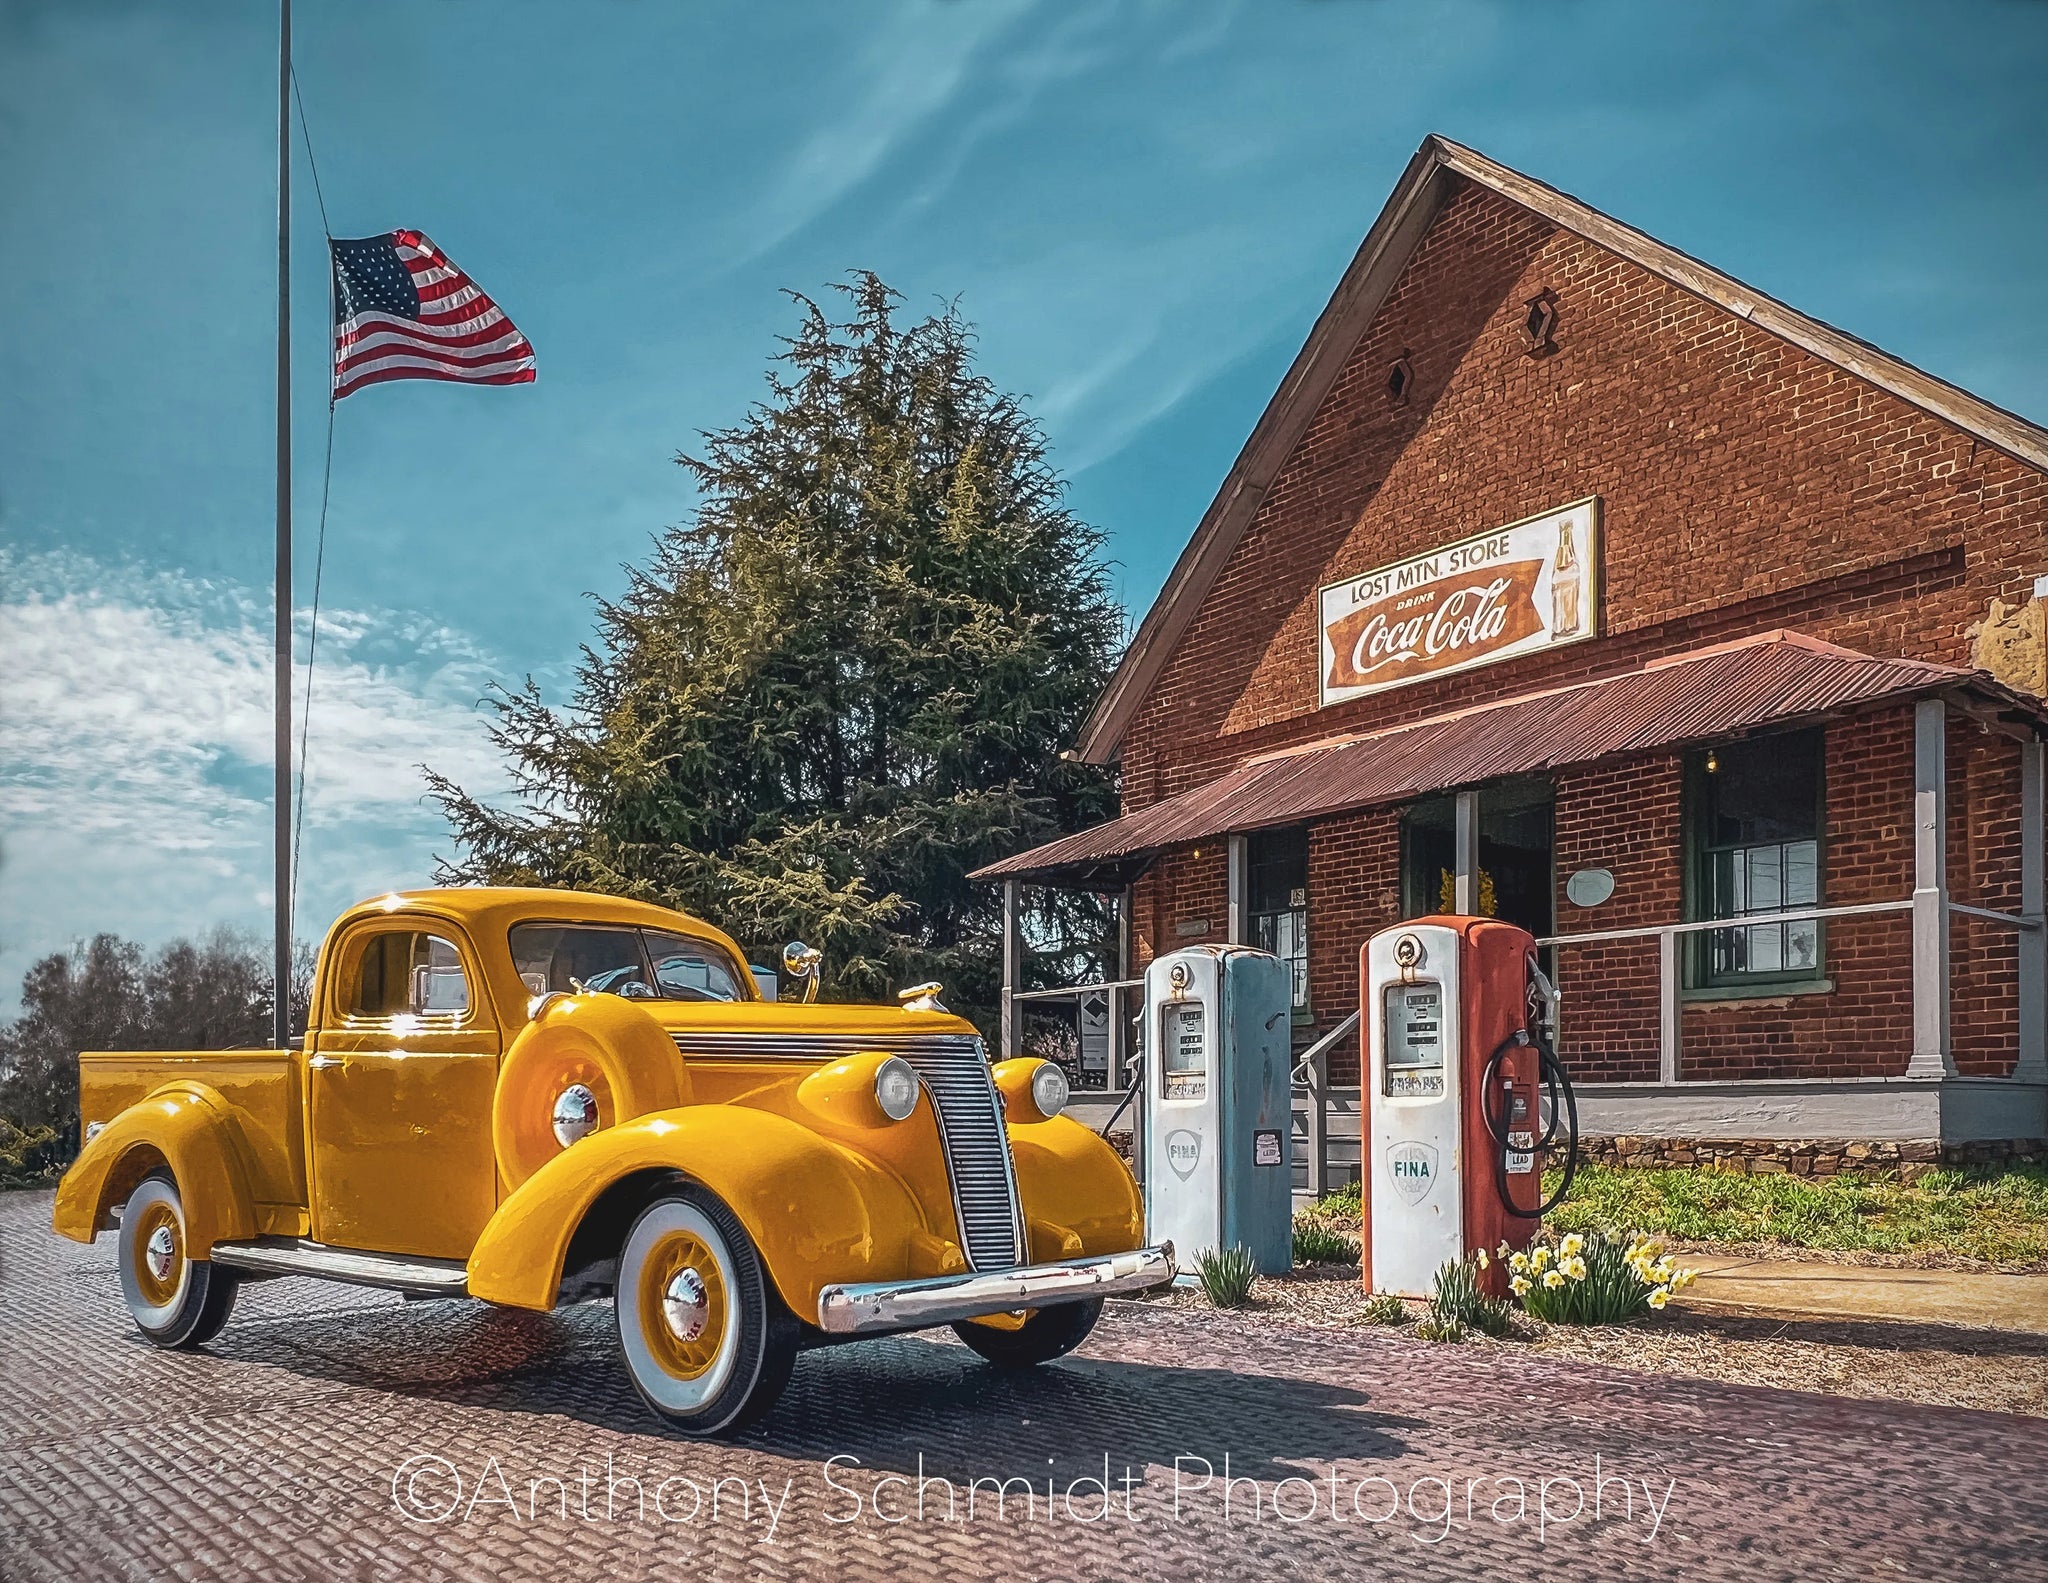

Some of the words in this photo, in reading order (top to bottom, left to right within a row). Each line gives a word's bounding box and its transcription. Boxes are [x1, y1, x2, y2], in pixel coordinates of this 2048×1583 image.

[1351, 574, 1391, 604] LOST
[1396, 558, 1443, 590] MTN.
[1449, 535, 1510, 572] STORE
[1396, 591, 1436, 611] DRINK
[1394, 1161, 1430, 1177] FINA
